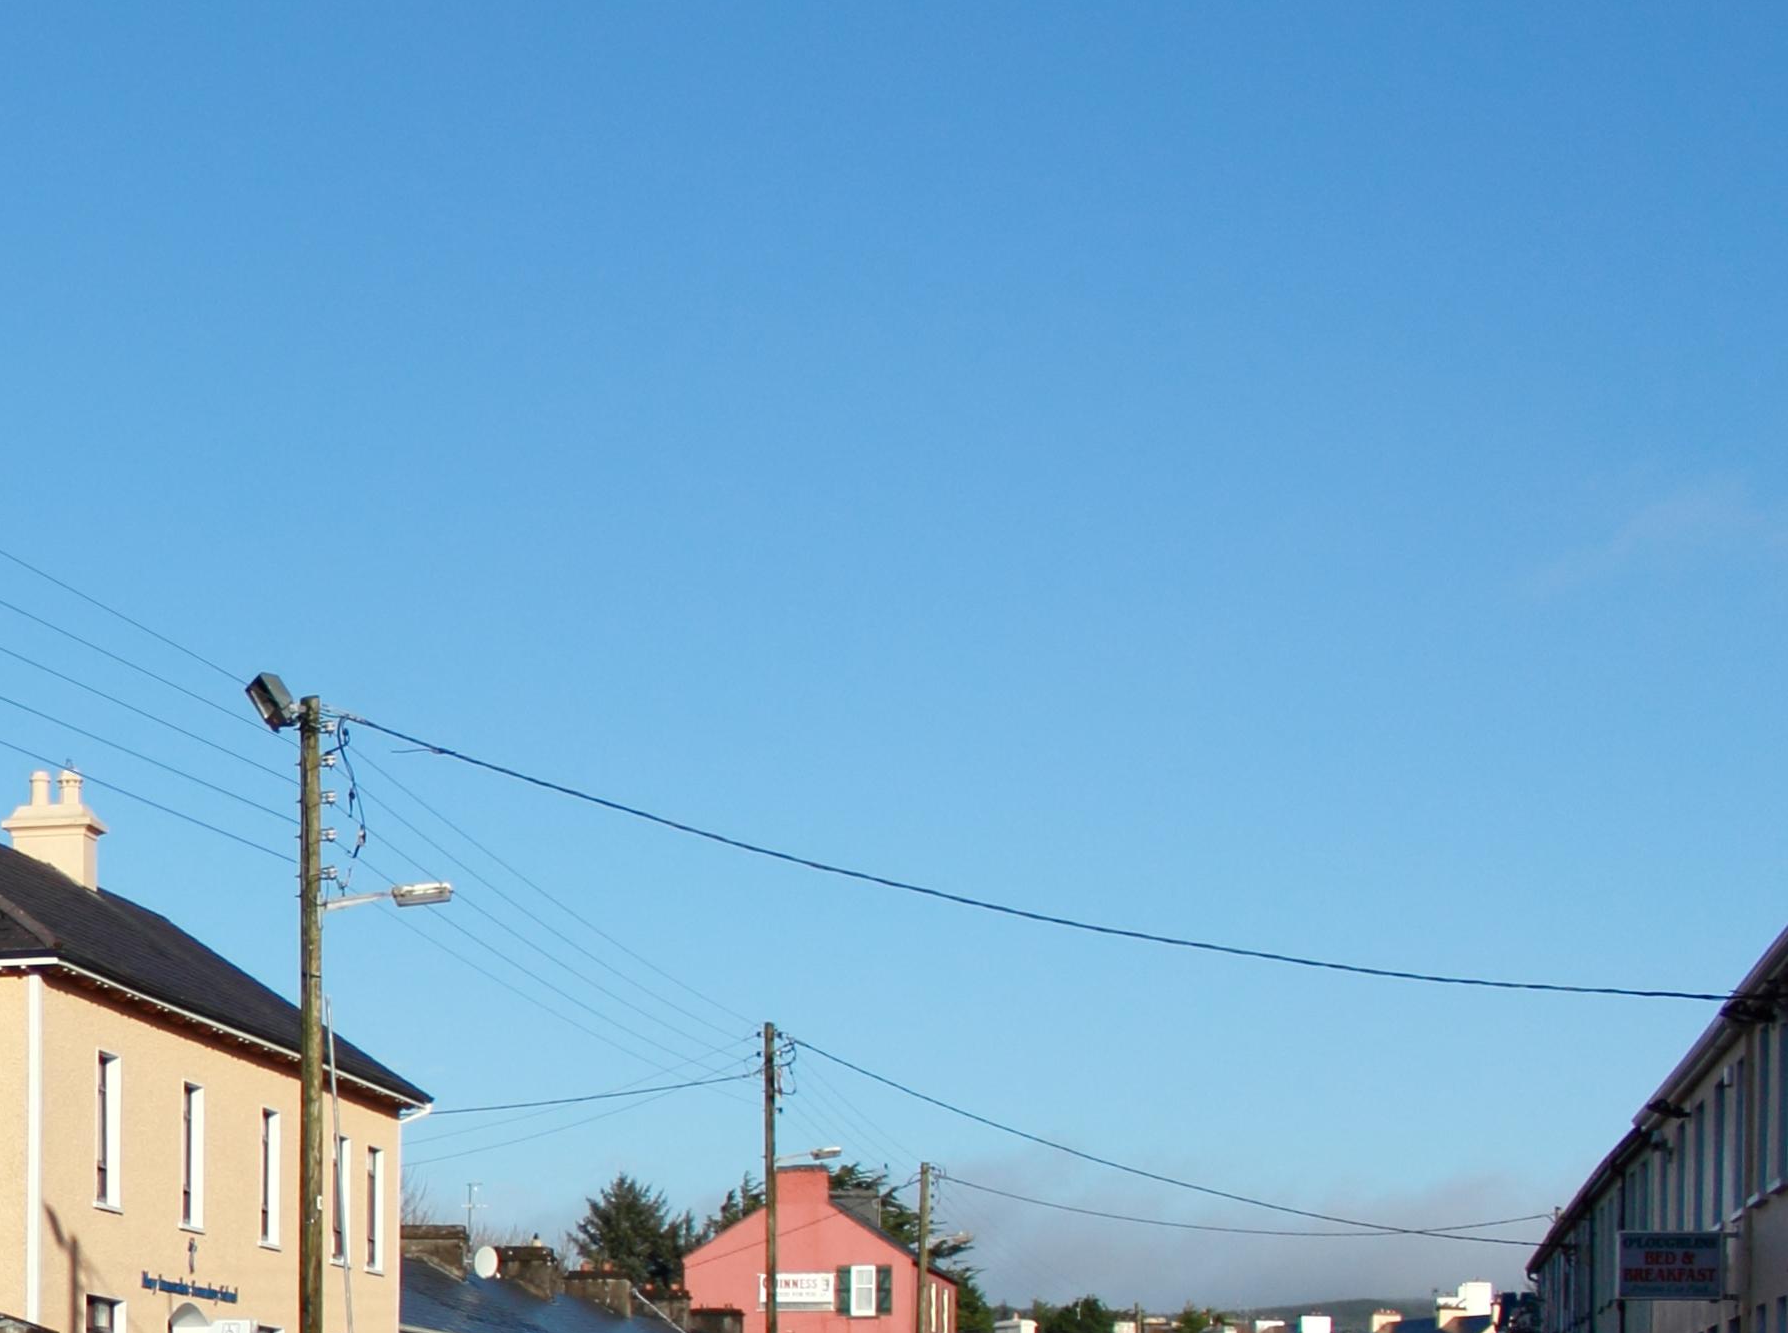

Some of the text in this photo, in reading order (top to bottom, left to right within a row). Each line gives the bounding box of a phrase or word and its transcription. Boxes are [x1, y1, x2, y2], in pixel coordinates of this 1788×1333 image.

[1644, 1251, 1695, 1265] BED &
[1623, 1268, 1717, 1282] BREAKFAST
